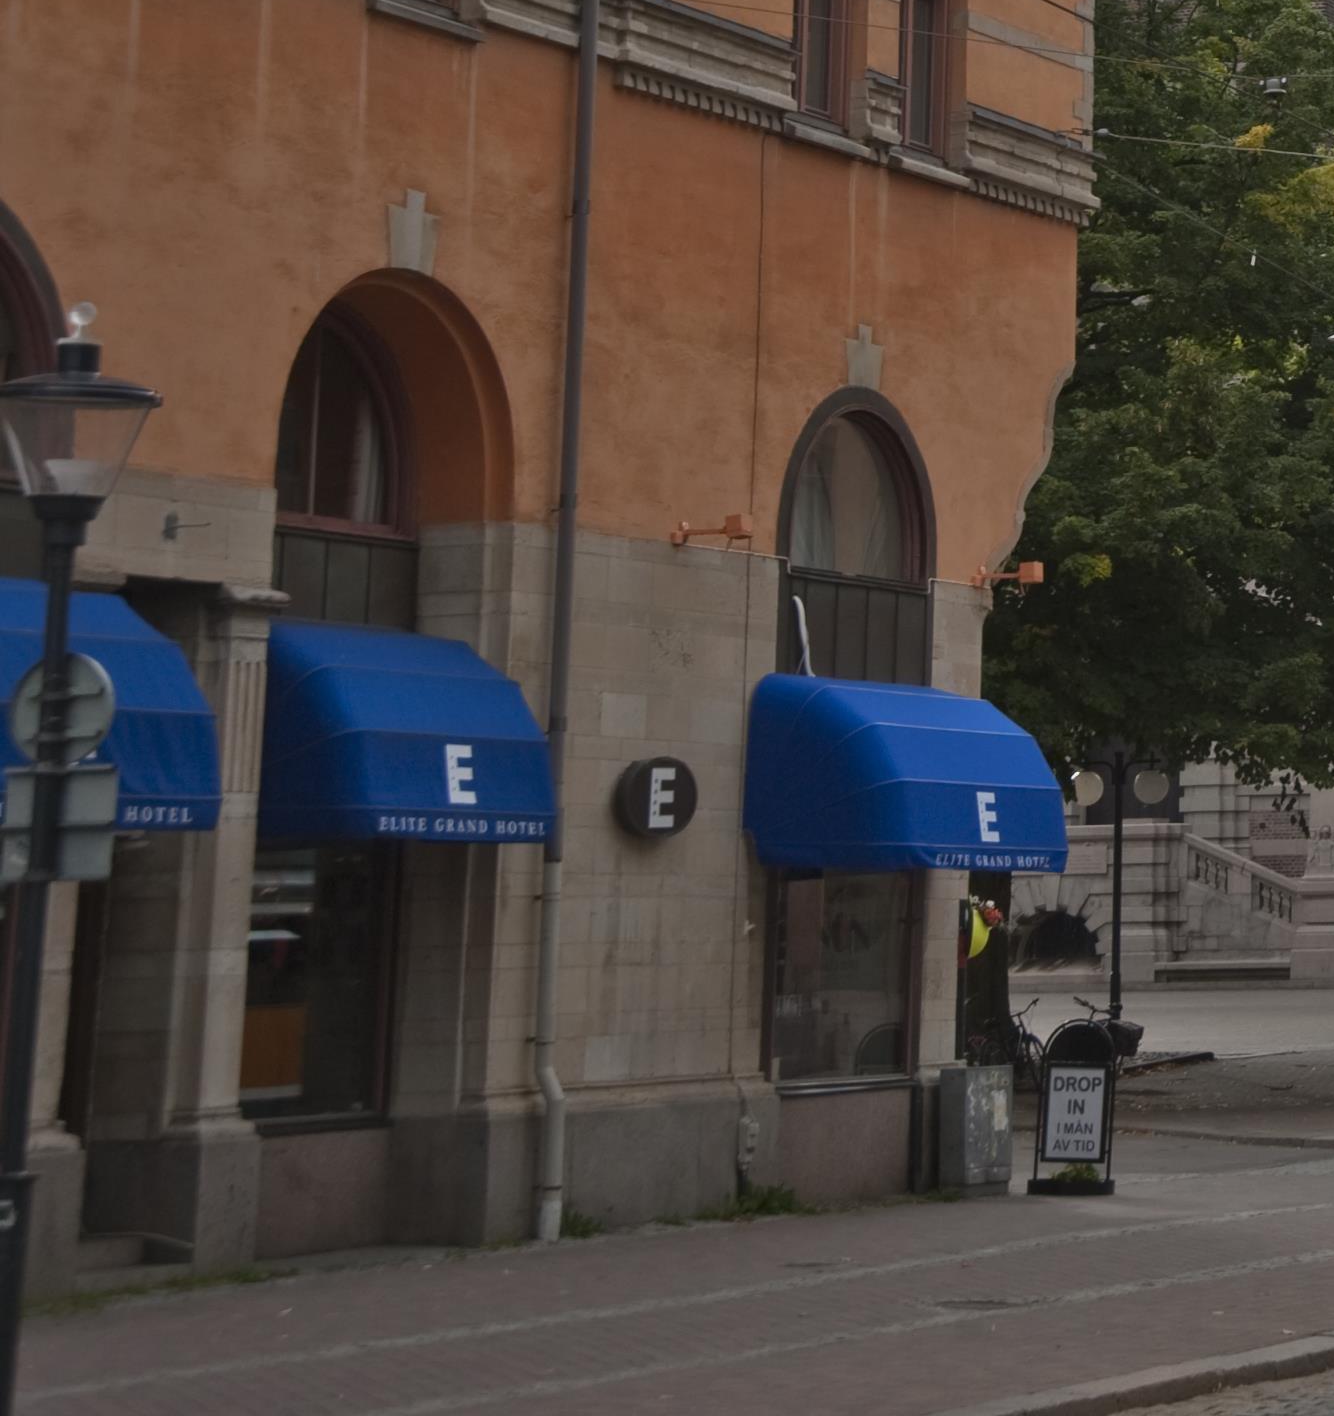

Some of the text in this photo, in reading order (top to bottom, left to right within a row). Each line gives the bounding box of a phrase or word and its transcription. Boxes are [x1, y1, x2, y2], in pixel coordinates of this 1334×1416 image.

[445, 743, 478, 804] E
[648, 767, 676, 828] E
[124, 805, 194, 823] HOTEL
[976, 791, 1001, 843] E
[378, 815, 547, 836] ELITE GRAND HOTEL
[935, 853, 1051, 868] ELITE GRAND HOTEL
[1053, 1076, 1102, 1093] DROP
[1067, 1098, 1085, 1115] IN
[1056, 1119, 1094, 1135] I MÅN
[1052, 1138, 1095, 1152] AV TID
